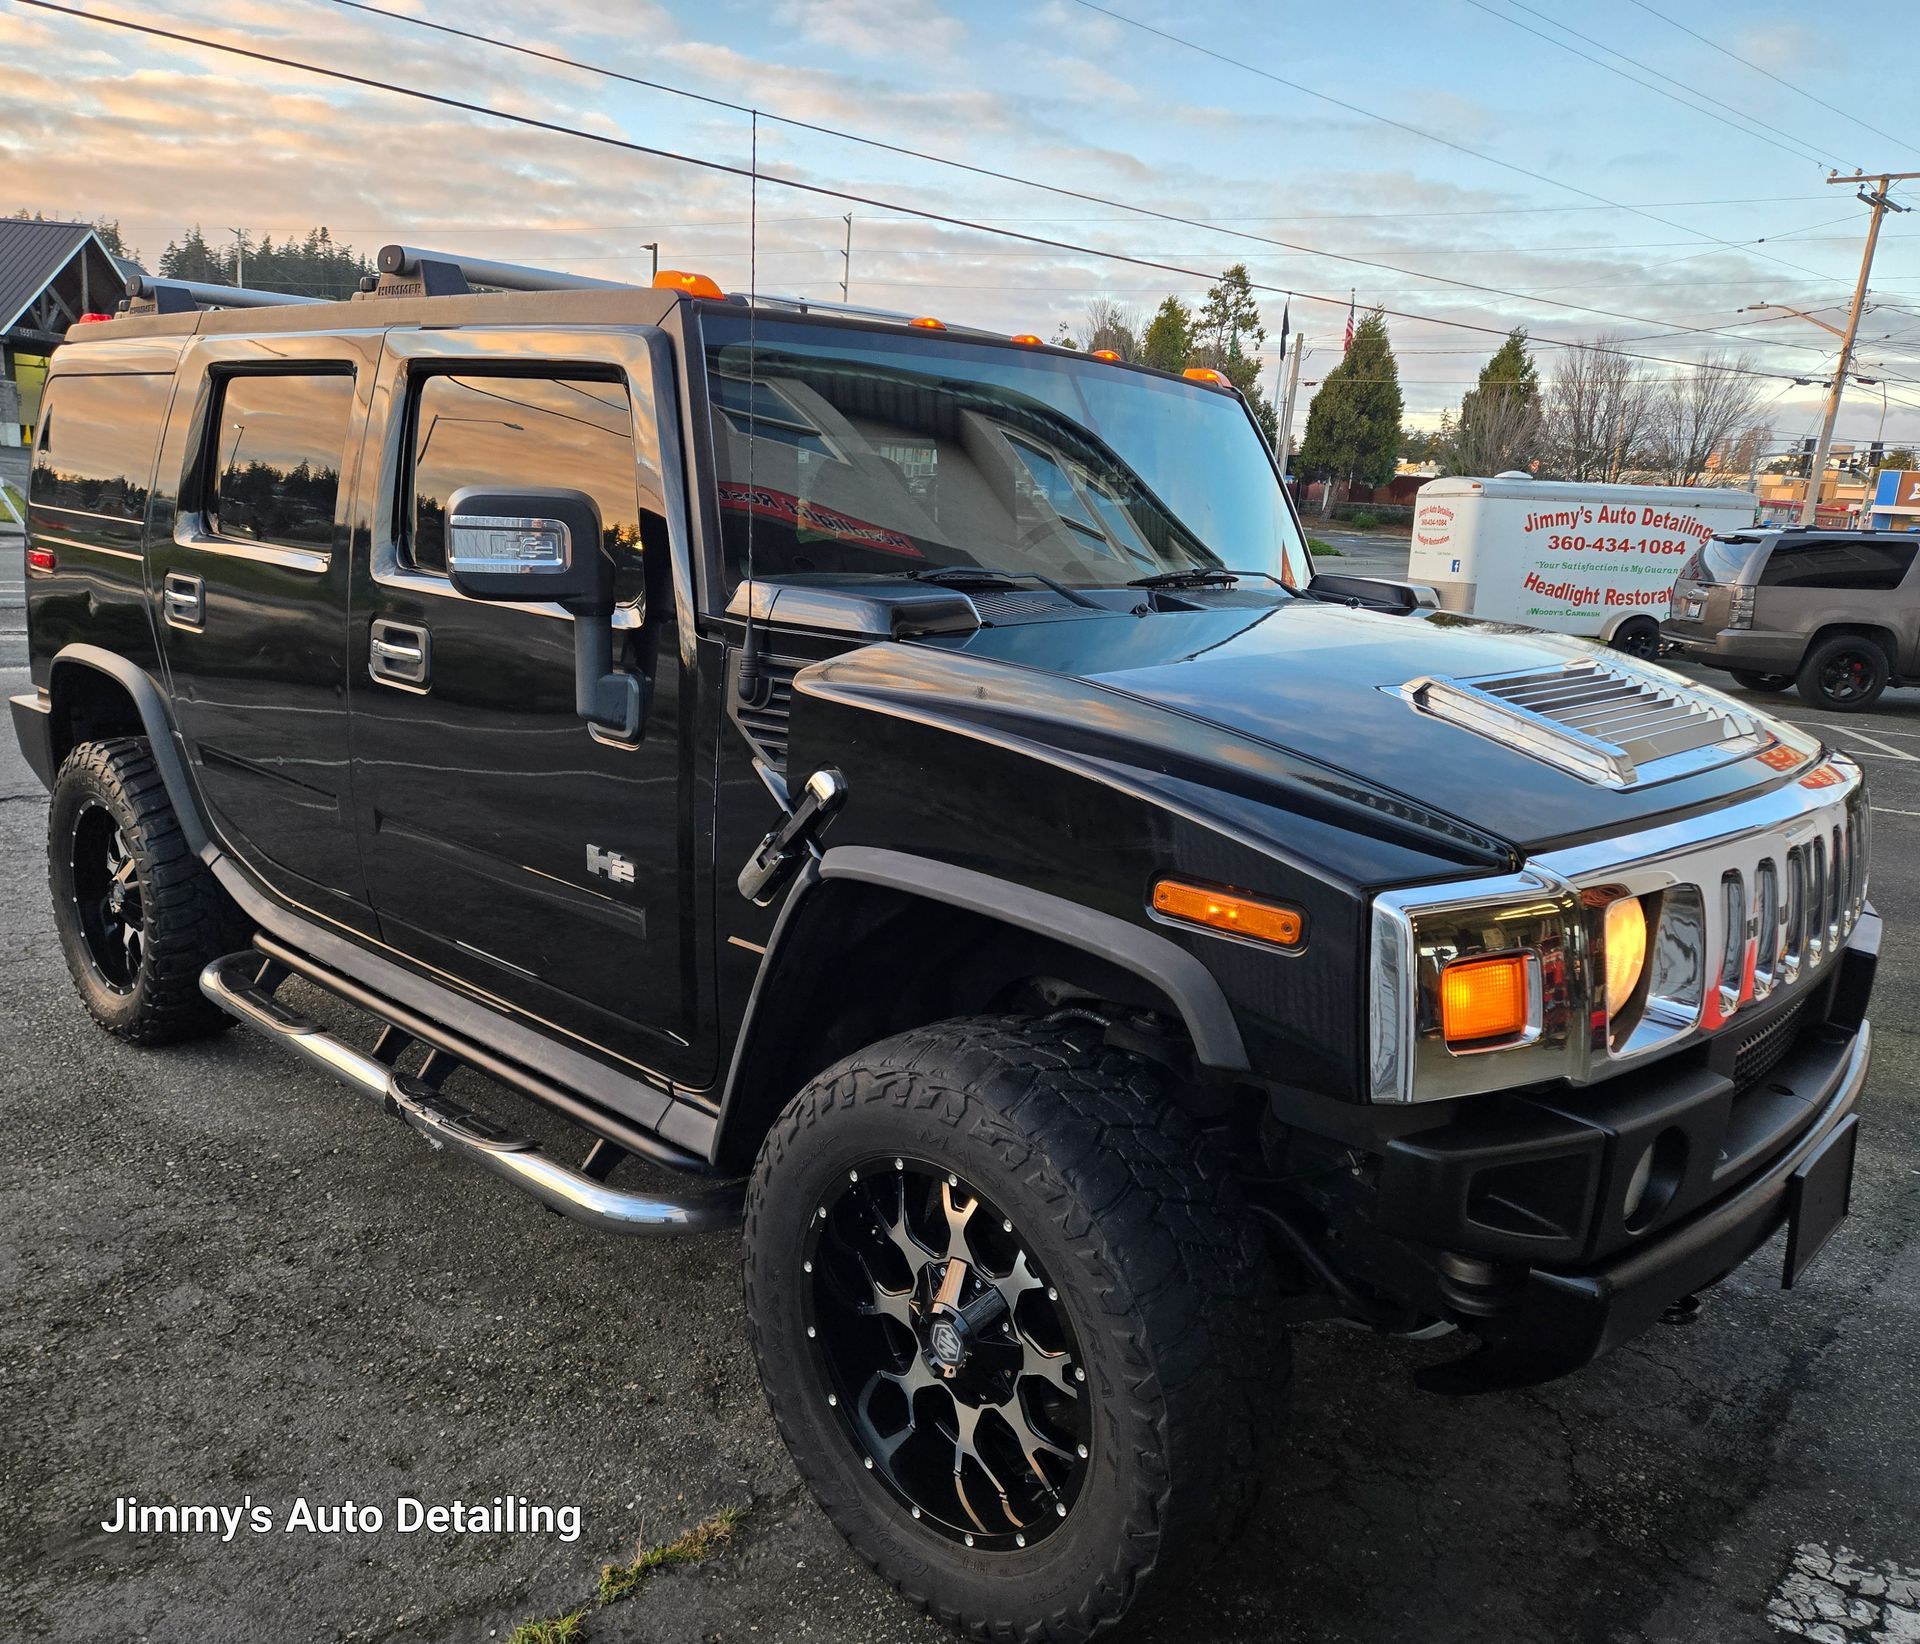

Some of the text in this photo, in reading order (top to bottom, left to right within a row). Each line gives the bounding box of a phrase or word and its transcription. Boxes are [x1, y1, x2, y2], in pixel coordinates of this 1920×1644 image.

[377, 283, 421, 297] HUMMER
[1524, 505, 1714, 545] Jimmy's Auto Detailing
[1548, 535, 1686, 555] 360-434-1084
[1561, 562, 1618, 572] Satisfaction
[1621, 564, 1629, 572] is
[1631, 565, 1643, 574] My
[1644, 565, 1680, 575] Guaran
[1524, 571, 1600, 607] Headlight
[586, 843, 635, 883] H2
